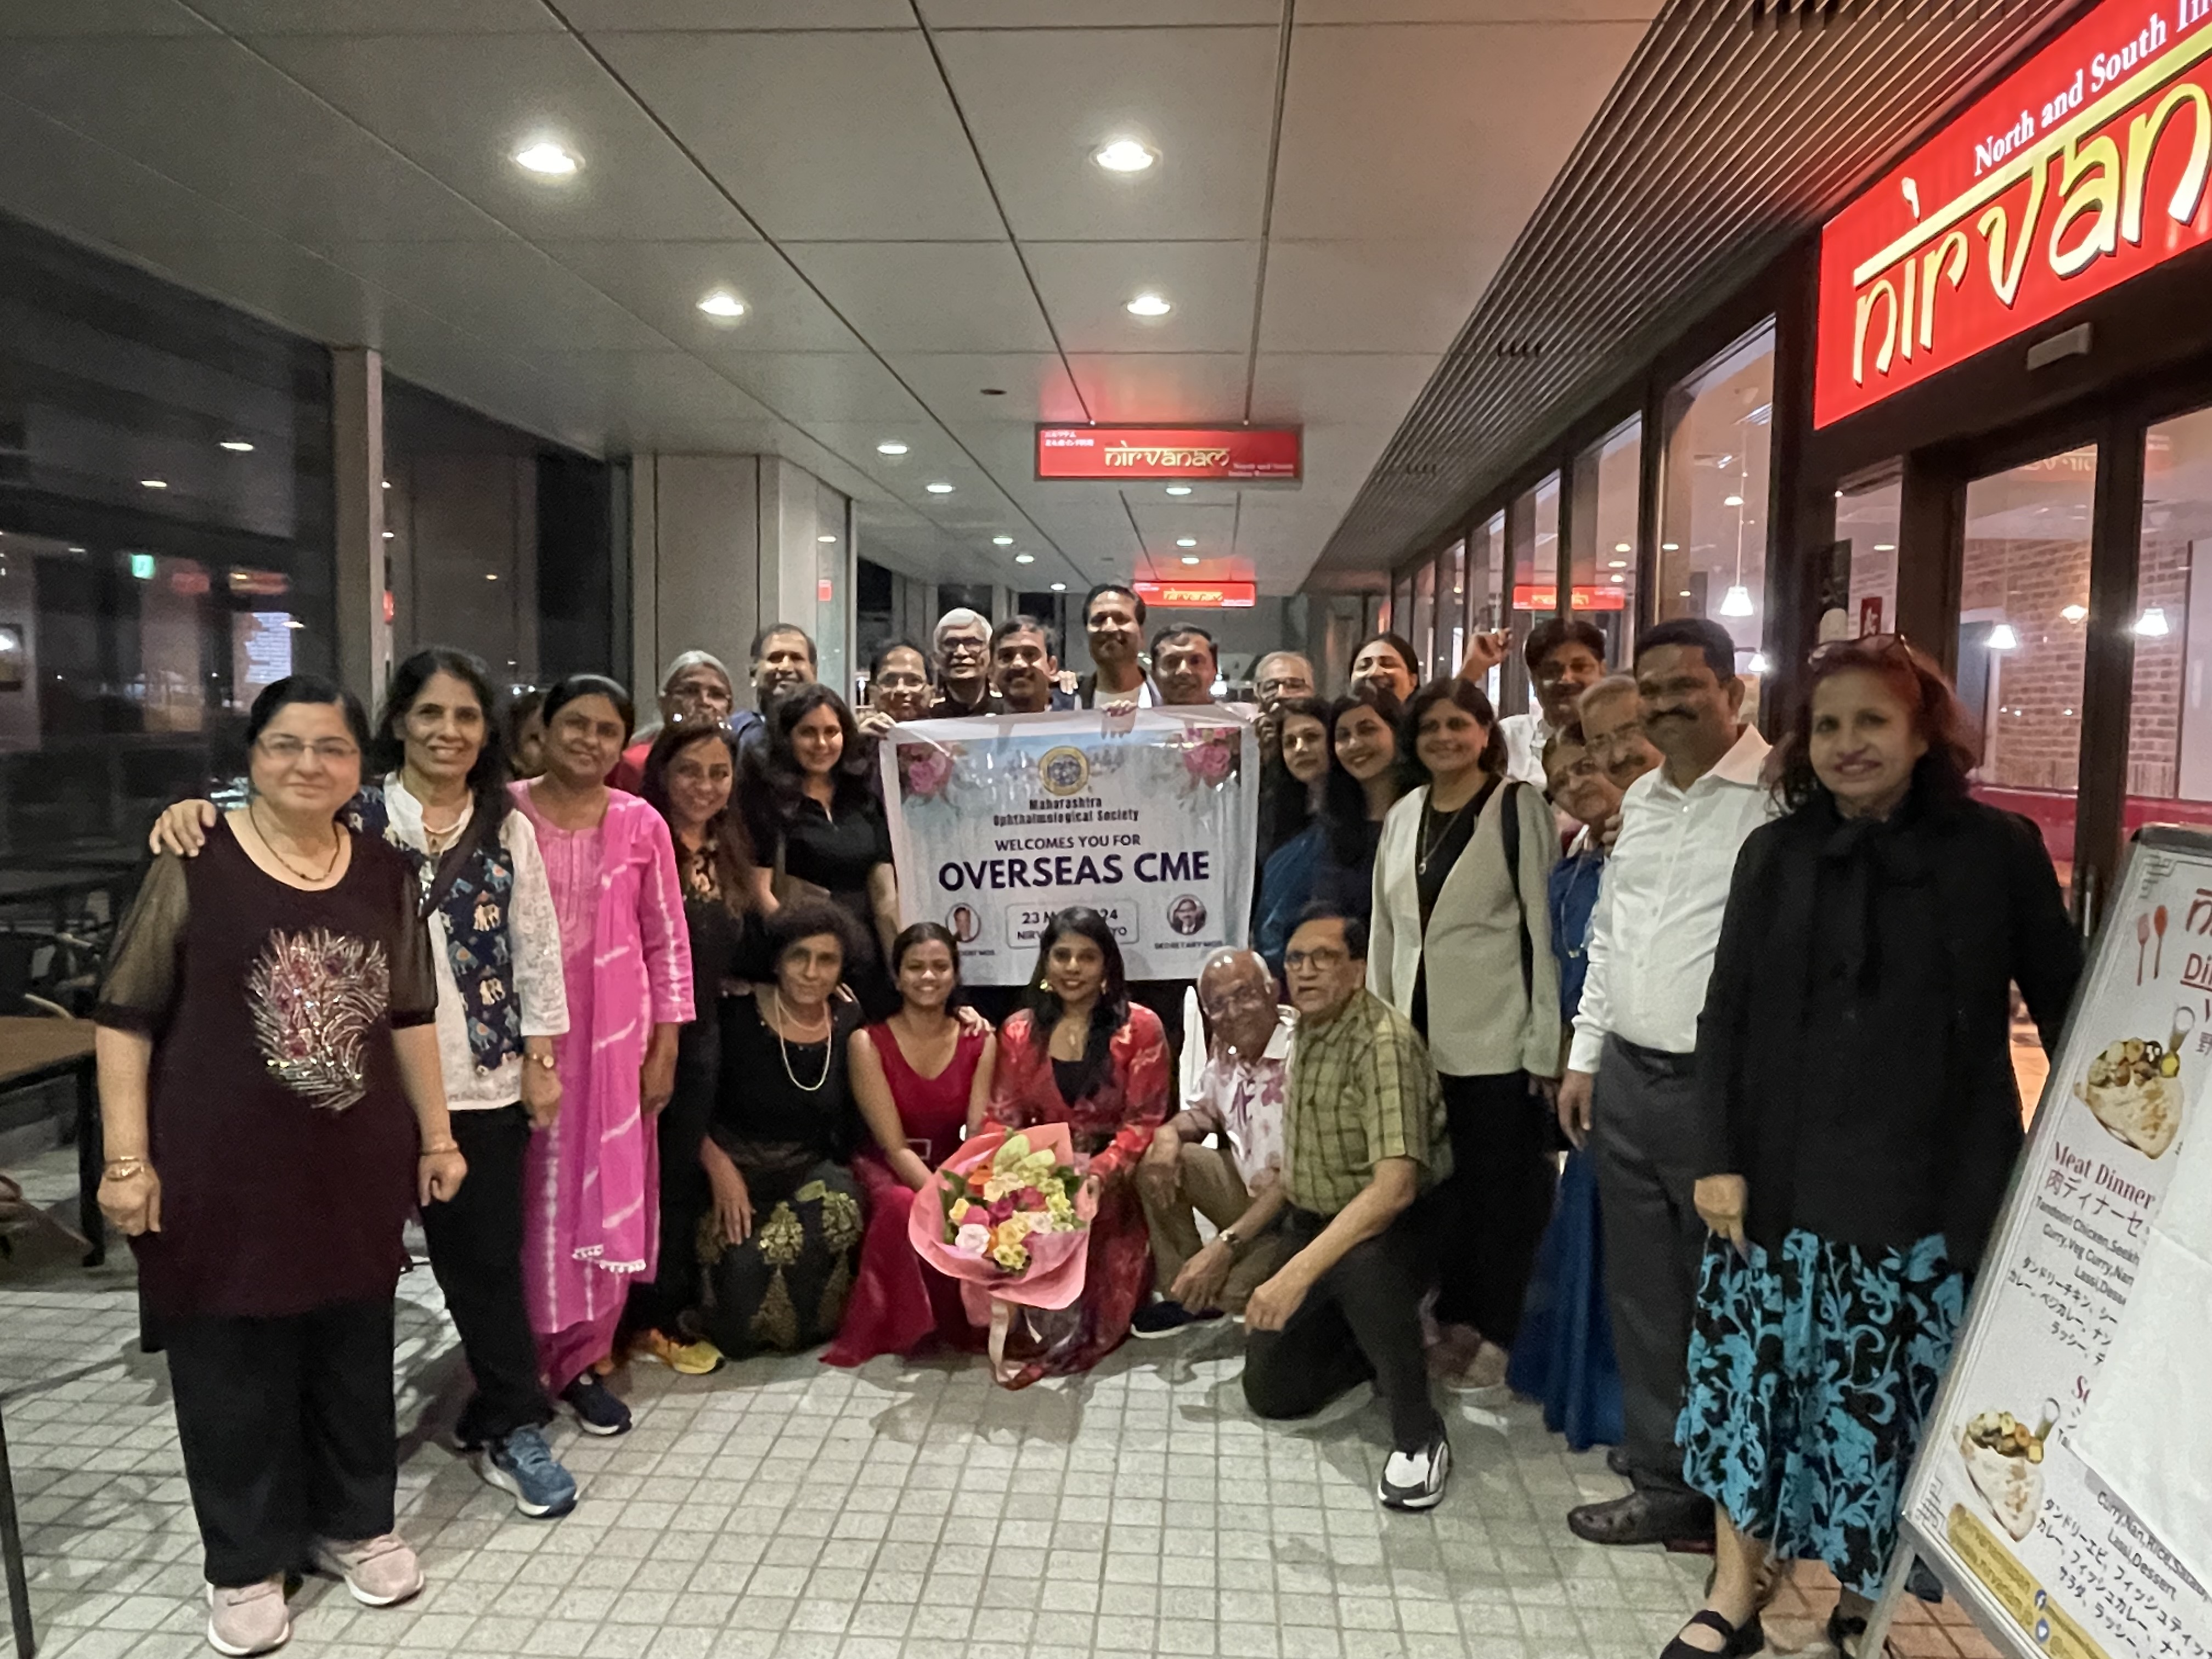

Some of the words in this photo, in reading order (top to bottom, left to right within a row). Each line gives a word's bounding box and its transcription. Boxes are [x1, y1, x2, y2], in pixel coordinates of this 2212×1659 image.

[1974, 110, 2035, 177] North
[2041, 69, 2084, 129] and
[2091, 12, 2167, 93] South
[2176, 0, 2212, 33] In
[1104, 439, 1231, 467] nirvanam
[1029, 797, 1102, 810] Maharashtra
[993, 810, 1093, 827] Ophthalmological
[1097, 809, 1139, 822] Society
[994, 836, 1074, 851] WELCOMES
[1078, 834, 1109, 848] YOU
[1113, 833, 1141, 847] FOR
[938, 854, 1124, 891] OVERSEAS
[1133, 850, 1210, 882] CME
[1022, 912, 1040, 924] 23
[2054, 1141, 2092, 1178] Meat
[2095, 1163, 2155, 1210] Dinner
[2045, 1169, 2150, 1246] 肉ディナーセ
